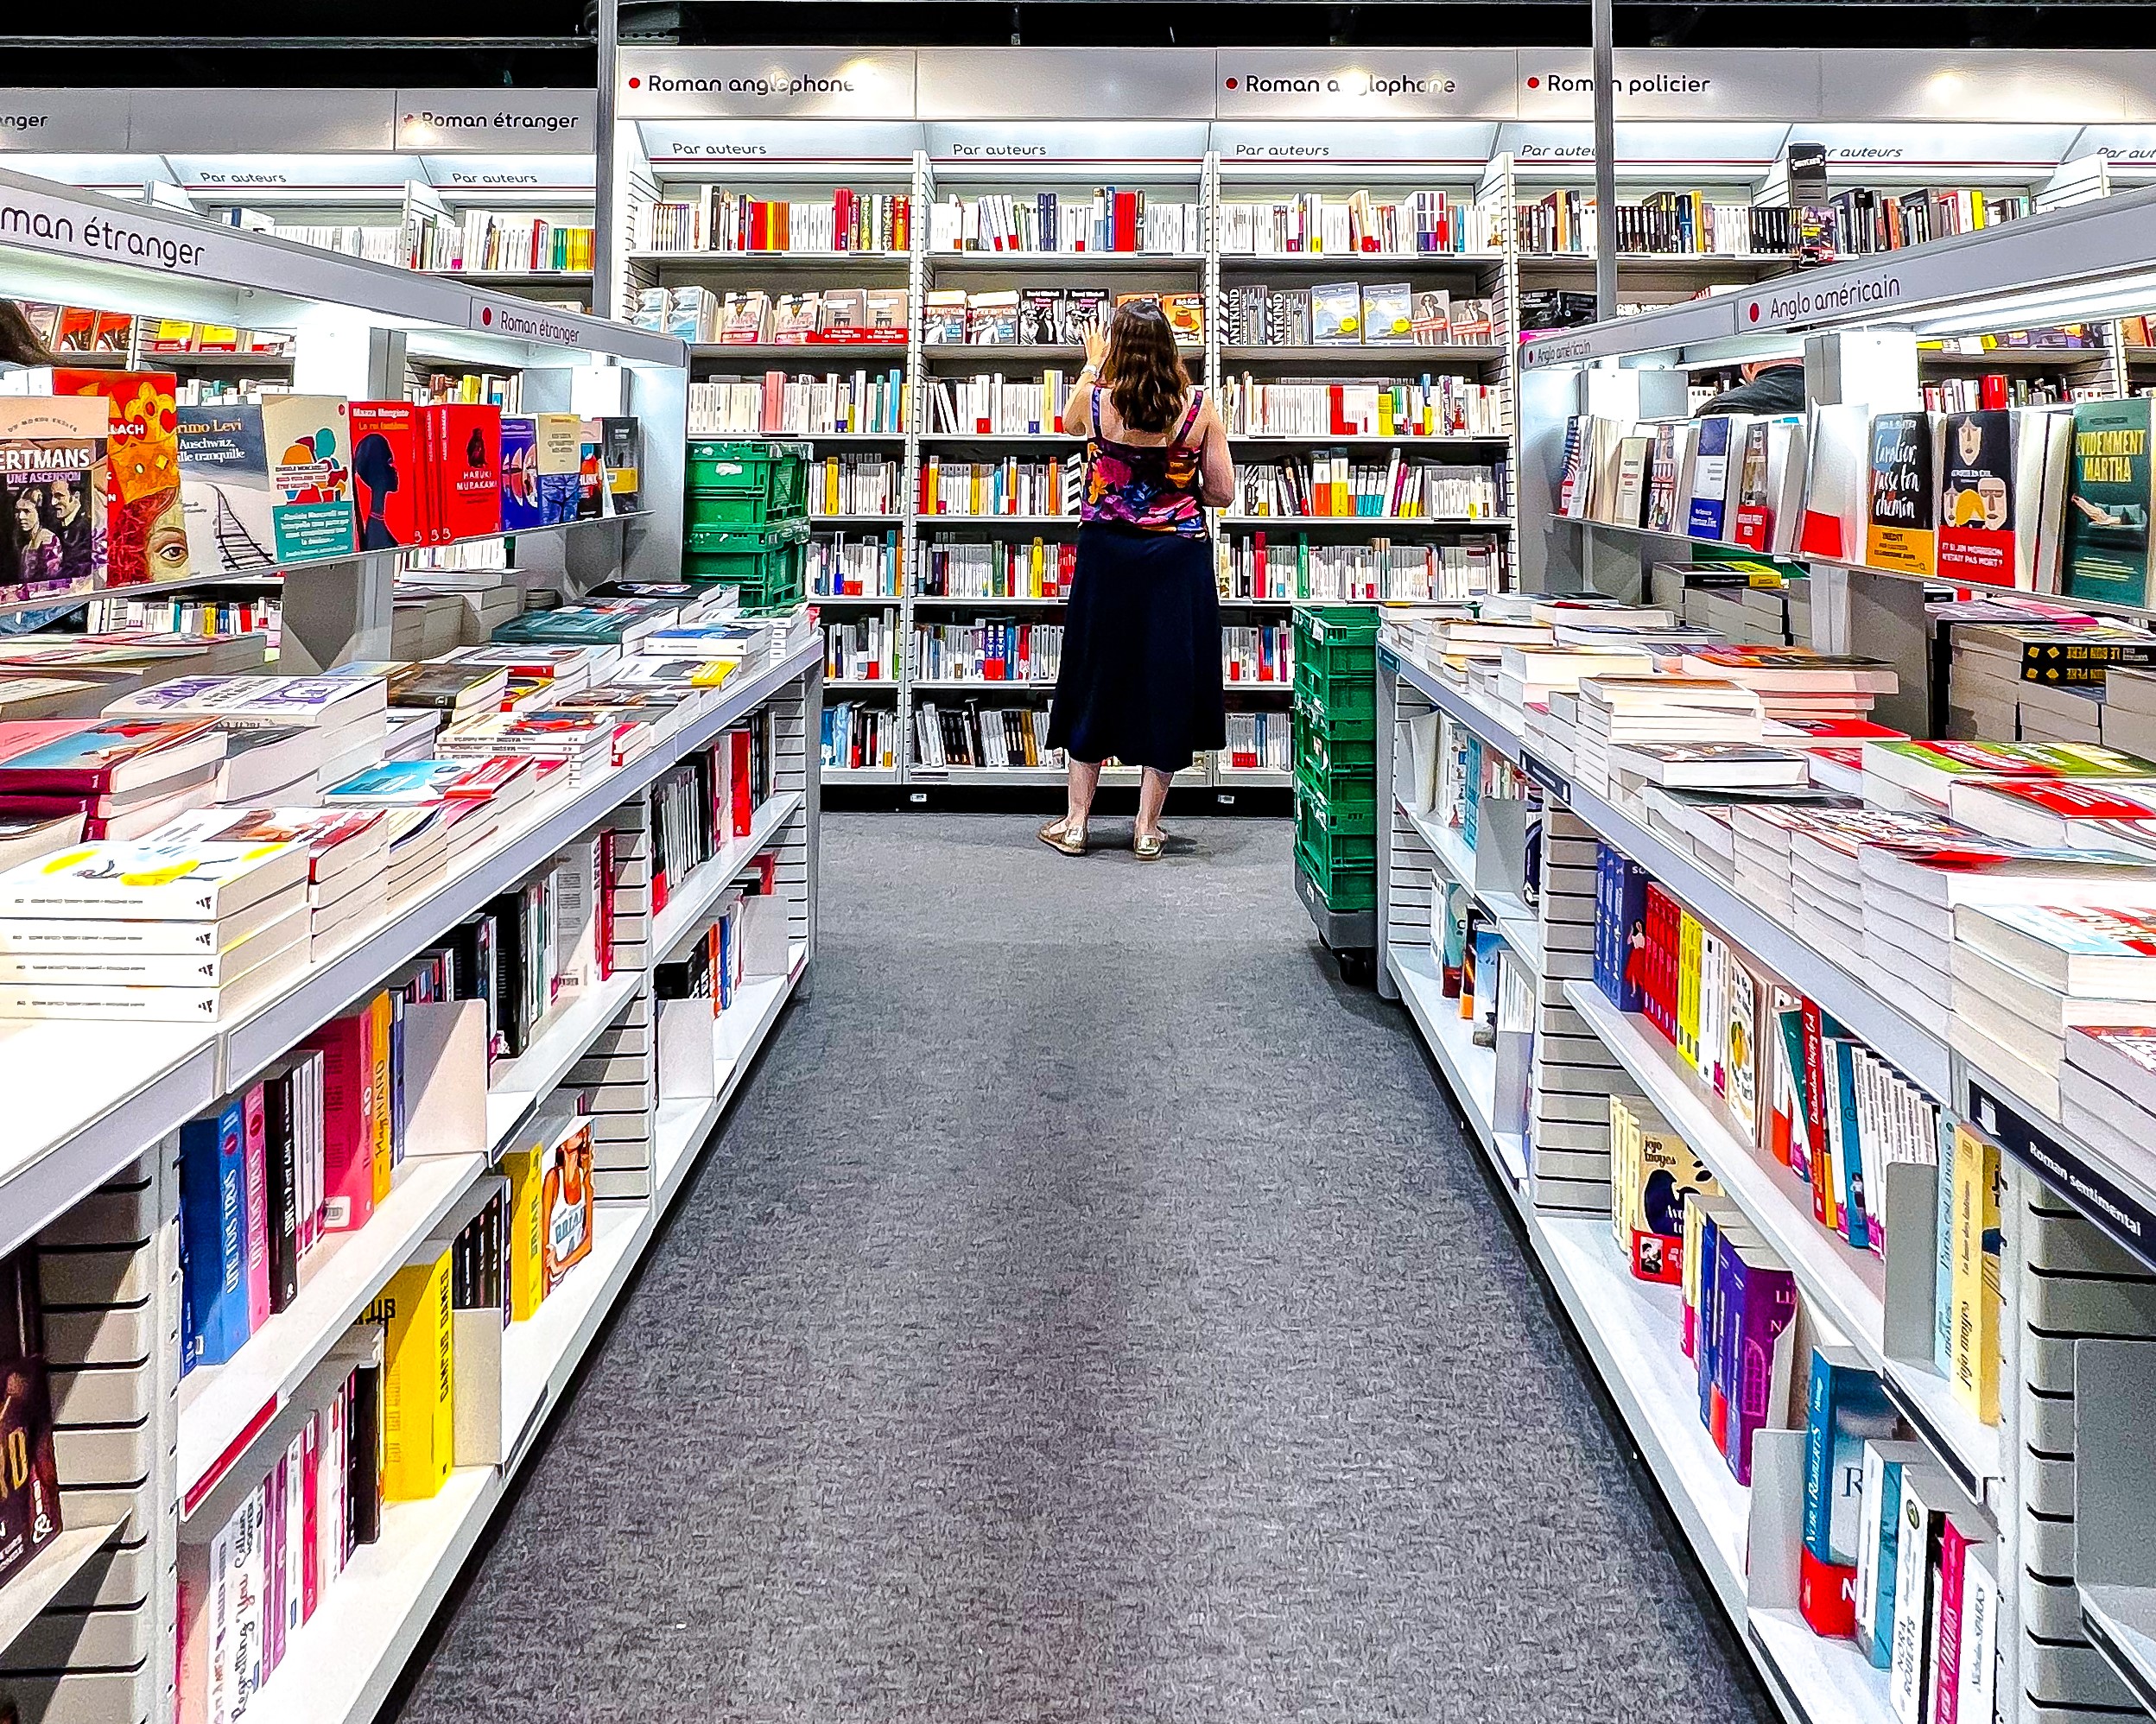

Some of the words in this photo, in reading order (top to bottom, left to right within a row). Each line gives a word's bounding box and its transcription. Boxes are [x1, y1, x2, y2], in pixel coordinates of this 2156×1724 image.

[648, 75, 722, 92] Roman
[1246, 75, 1320, 92] Roman
[1328, 75, 1455, 96] alophone
[1548, 74, 1622, 92] Romn
[1629, 74, 1710, 96] policier
[493, 111, 579, 131] étranger
[672, 143, 701, 155] Par
[706, 143, 767, 155] auteurs
[953, 143, 981, 155] Par
[986, 144, 1047, 155] auteurs
[1236, 144, 1264, 156] Par
[1267, 145, 1329, 156] auteurs
[1521, 144, 1550, 156] Par
[1841, 147, 1904, 159] auteurs
[200, 172, 227, 184] Par
[231, 172, 287, 184] auteurs
[452, 173, 476, 183] Par
[483, 173, 538, 183] auteurs
[84, 216, 206, 268] étranger
[1770, 289, 1810, 320] Anglo
[1814, 275, 1901, 312] américain
[499, 310, 537, 336] Roman
[539, 319, 580, 345] étranger
[213, 416, 243, 432] Levi
[194, 448, 245, 464] tranquille
[2083, 456, 2132, 483] MARTHA
[2029, 1140, 2068, 1181] Roman
[2070, 1171, 2142, 1238] sentimental
[283, 1203, 295, 1238] LOVE
[234, 1574, 256, 1623] You
[1897, 1620, 1906, 1672] NORA
[1903, 1616, 1916, 1697] ROBERTS
